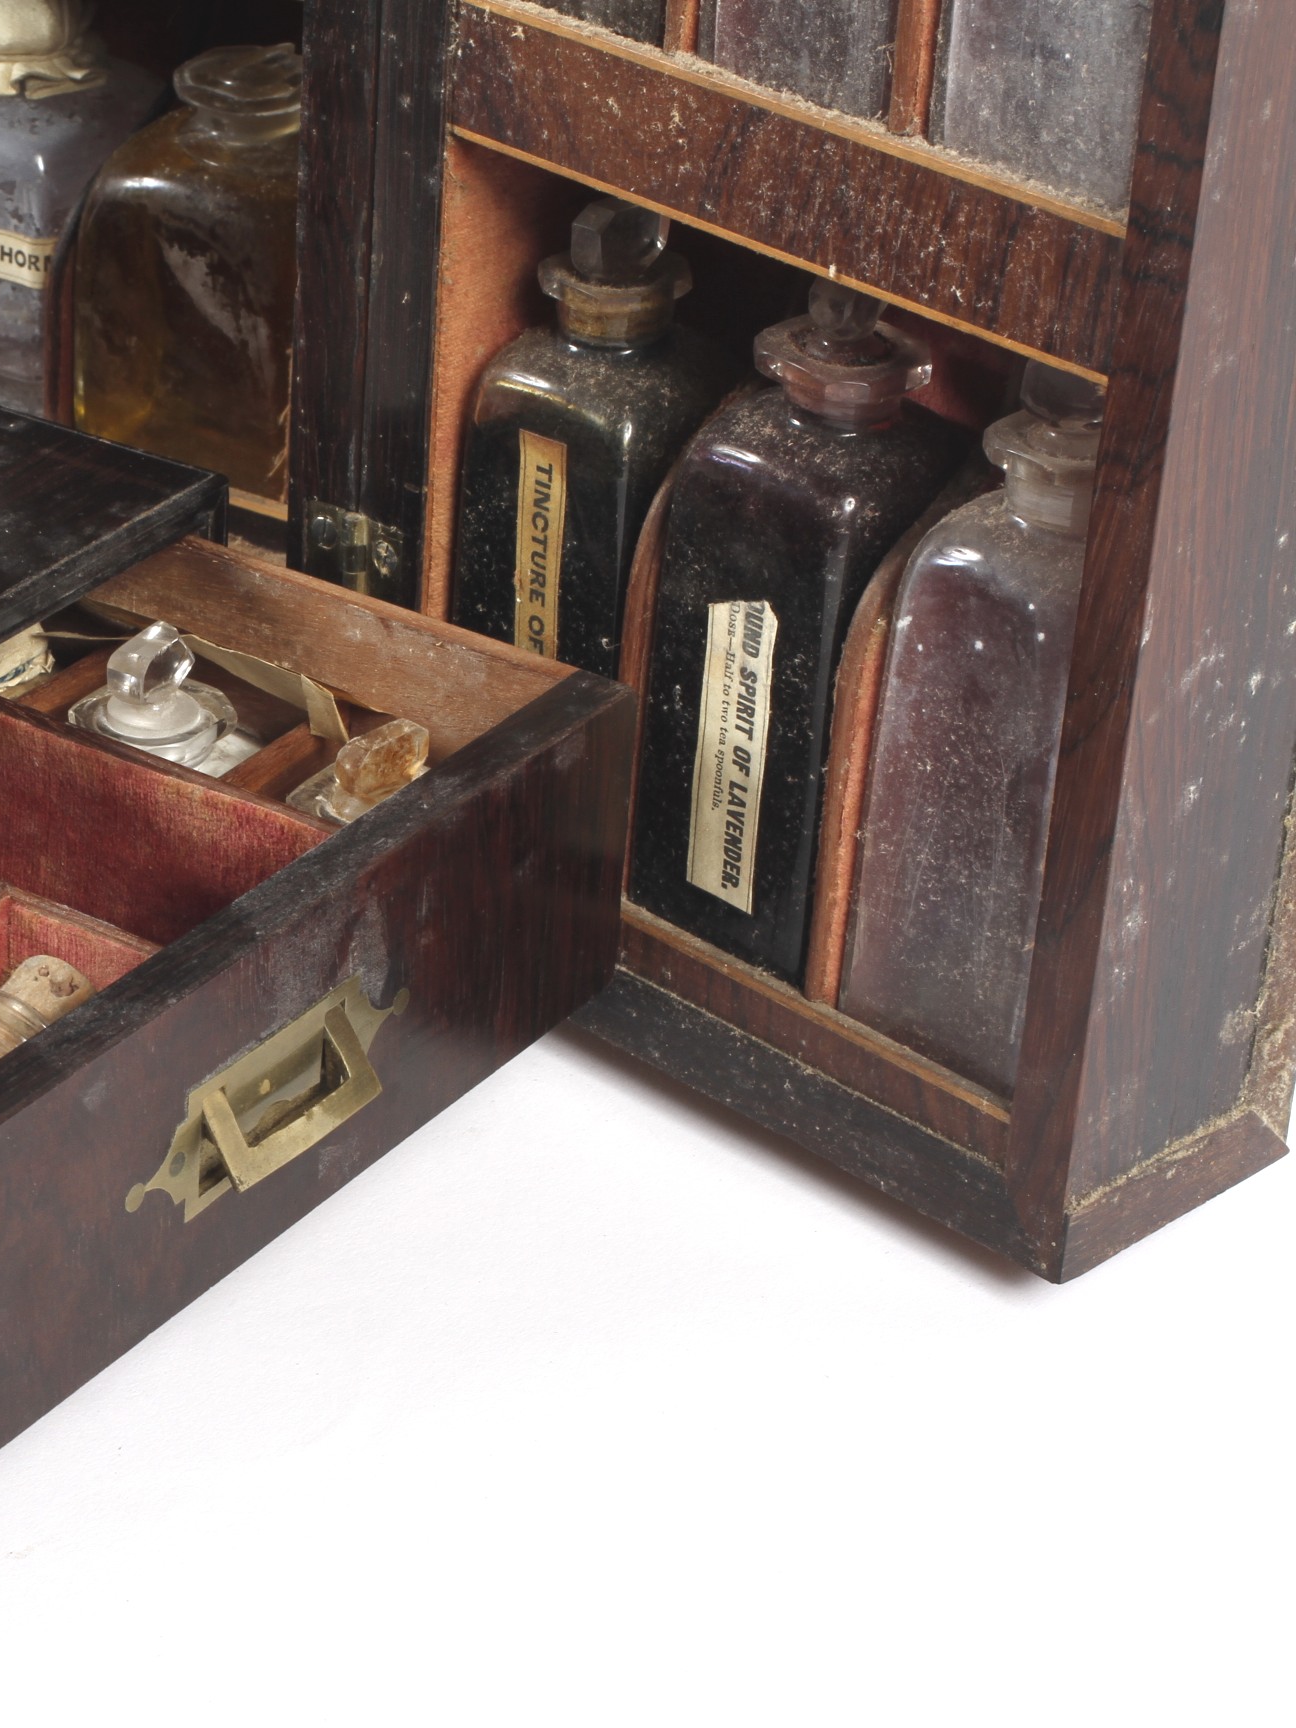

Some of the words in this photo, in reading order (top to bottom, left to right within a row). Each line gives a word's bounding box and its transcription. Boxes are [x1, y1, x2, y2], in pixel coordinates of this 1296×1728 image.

[528, 462, 554, 608] TINCTURE
[527, 615, 546, 658] OF
[720, 700, 732, 723] two
[722, 683, 733, 697] to
[734, 667, 758, 742] SPIRIT
[718, 726, 730, 746] tea
[710, 749, 727, 812] spoonfuls.
[731, 745, 751, 778] OF
[721, 780, 747, 890] LAVENDER.
